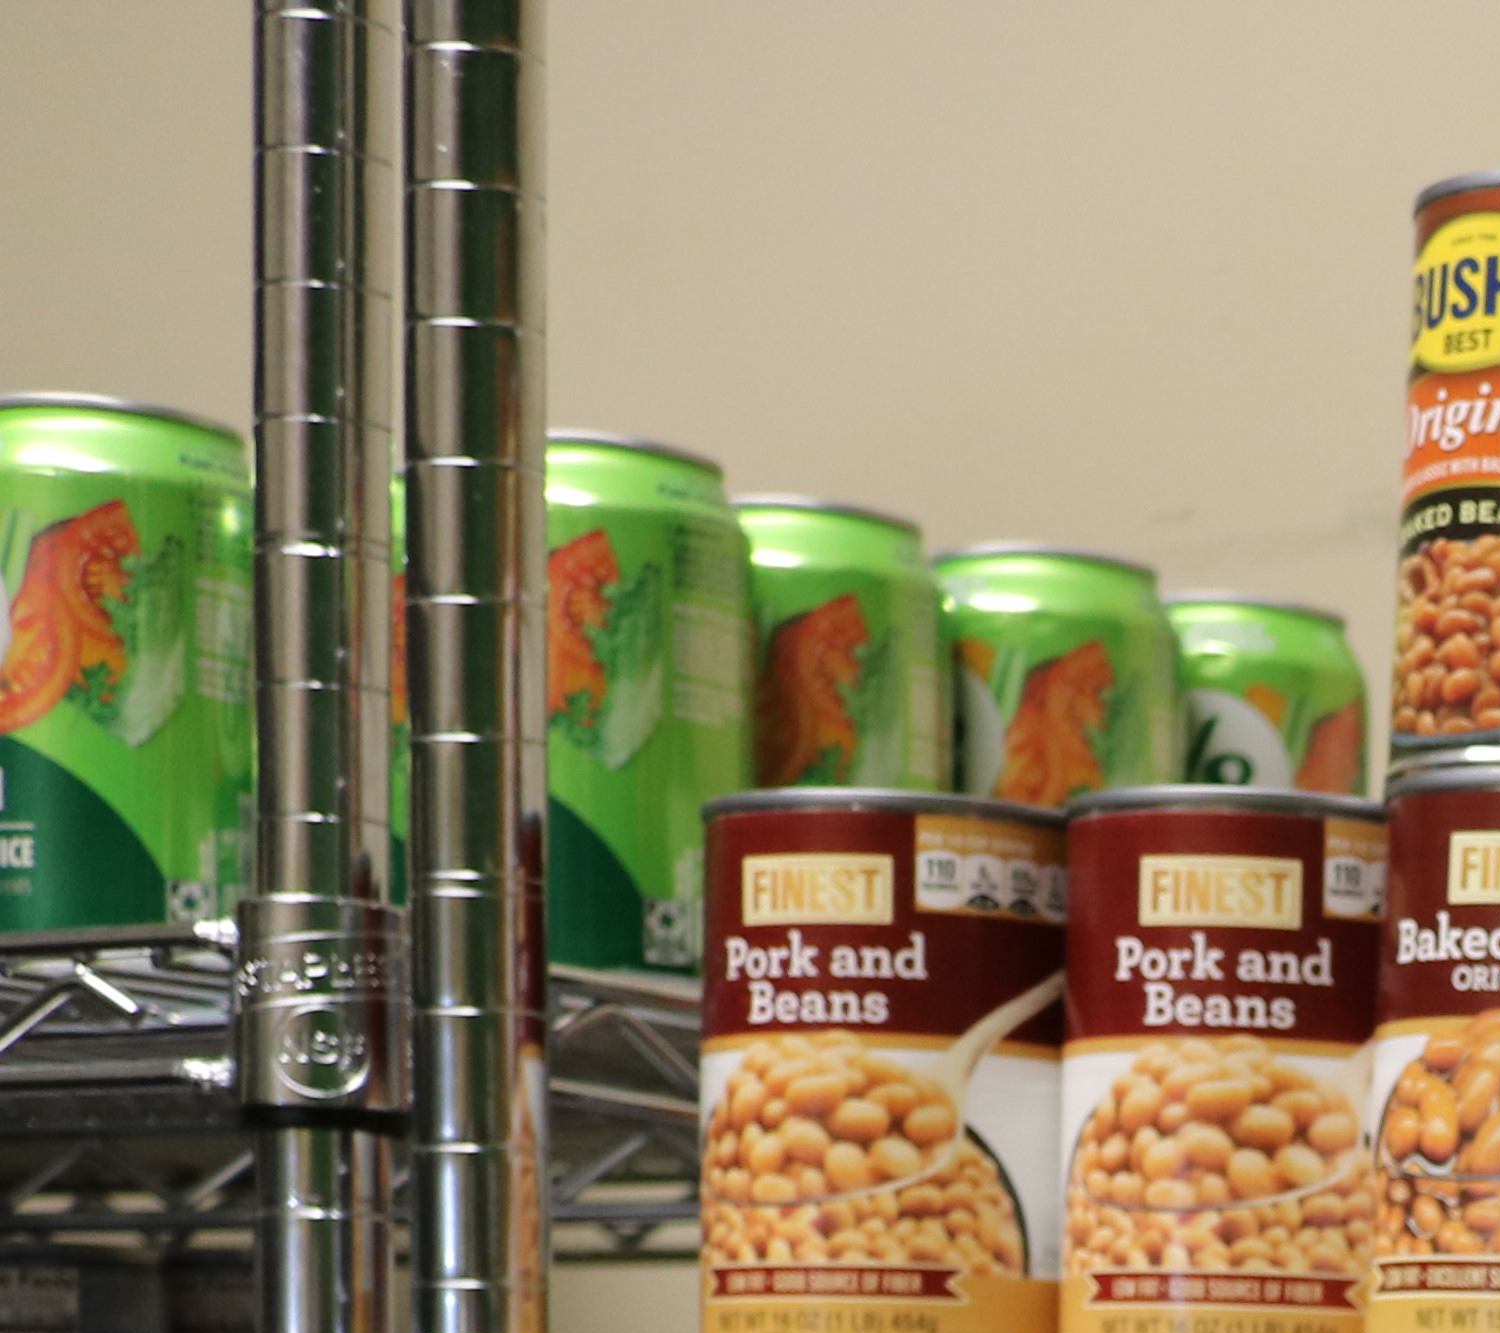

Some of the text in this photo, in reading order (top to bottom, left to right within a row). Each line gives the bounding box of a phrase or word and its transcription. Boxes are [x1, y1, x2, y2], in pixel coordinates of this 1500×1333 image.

[1443, 329, 1494, 355] BEST
[753, 867, 880, 913] FINEST
[1150, 866, 1292, 916] FINEST
[725, 929, 927, 981] Pork and
[1115, 933, 1334, 987] Pork and
[747, 982, 890, 1026] Beans
[1143, 982, 1296, 1030] Beans
